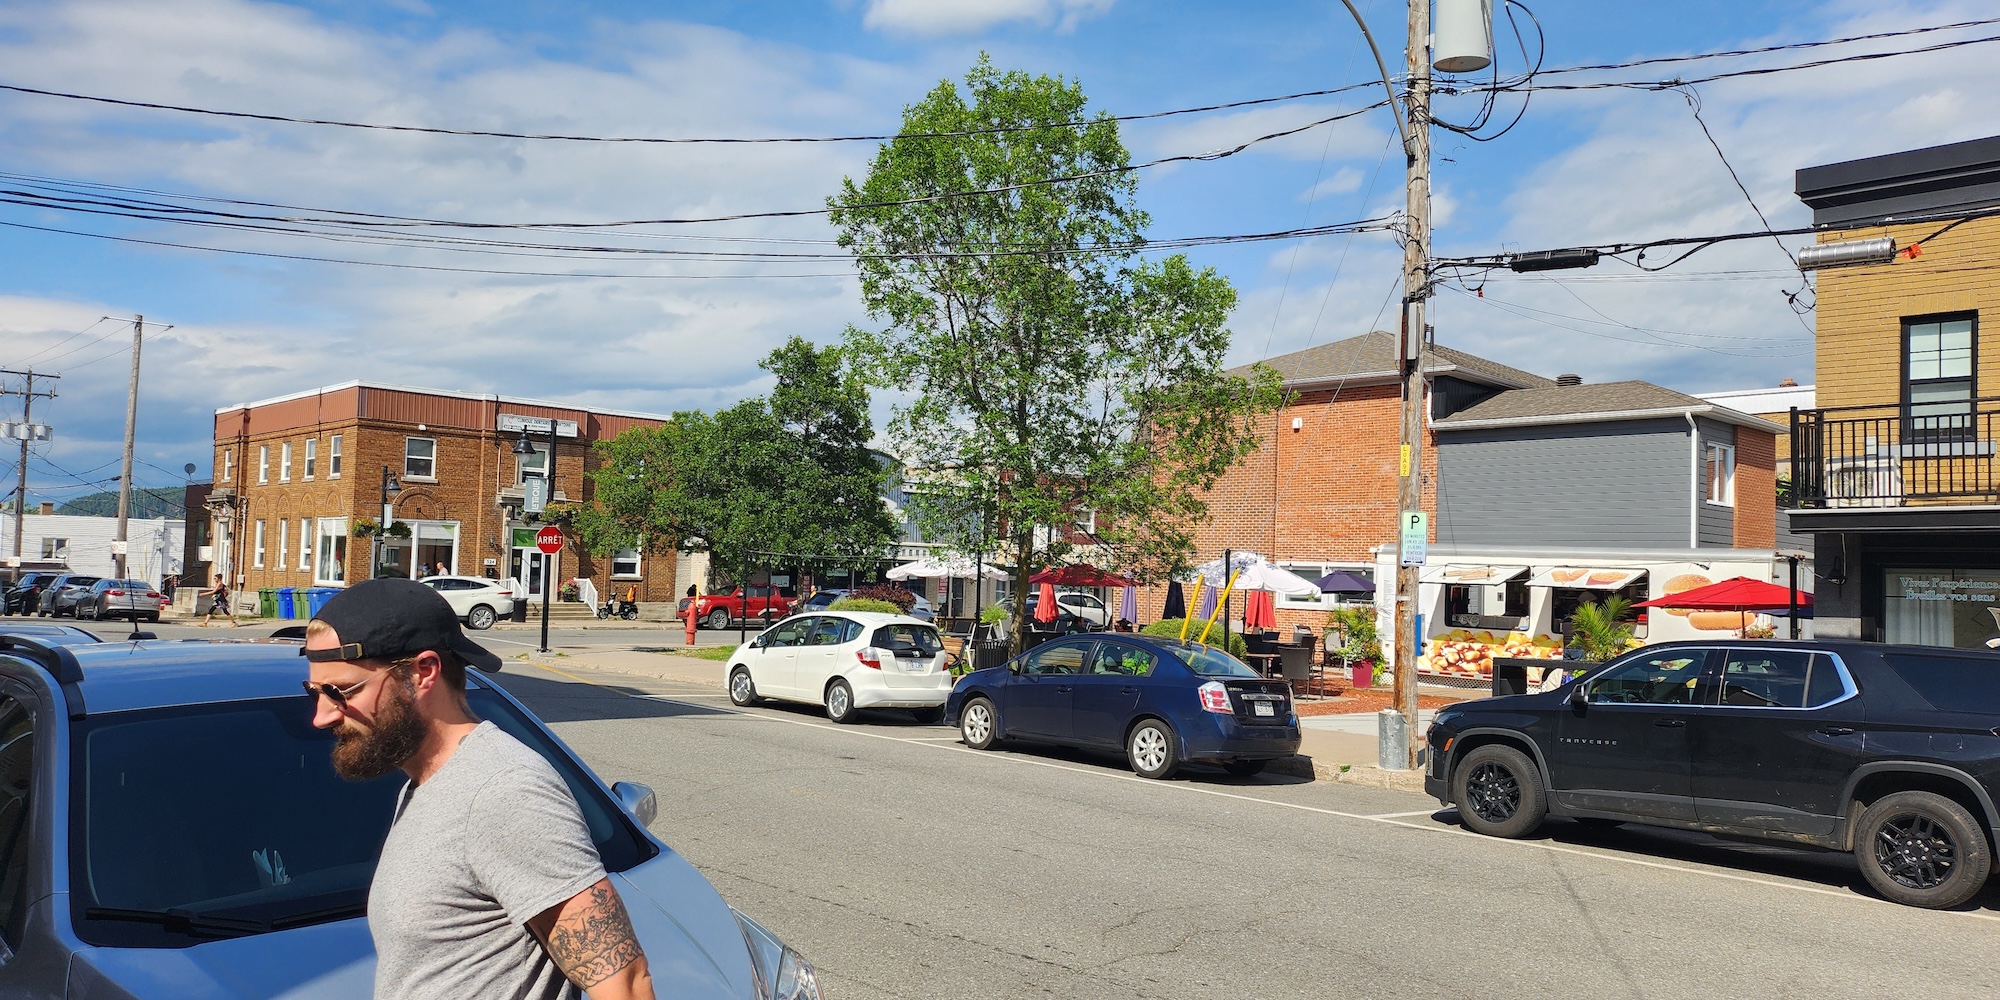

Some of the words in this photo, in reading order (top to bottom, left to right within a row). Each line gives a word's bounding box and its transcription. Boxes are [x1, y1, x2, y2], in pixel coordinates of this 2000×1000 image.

[1411, 514, 1420, 529] P
[538, 535, 562, 544] ARRÊT
[1900, 577, 1930, 588] Vivez
[1905, 588, 1947, 601] Éveillez
[1949, 593, 1968, 602] vos
[1971, 593, 1995, 602] sens
[1560, 737, 1617, 746] TRAVERSE
